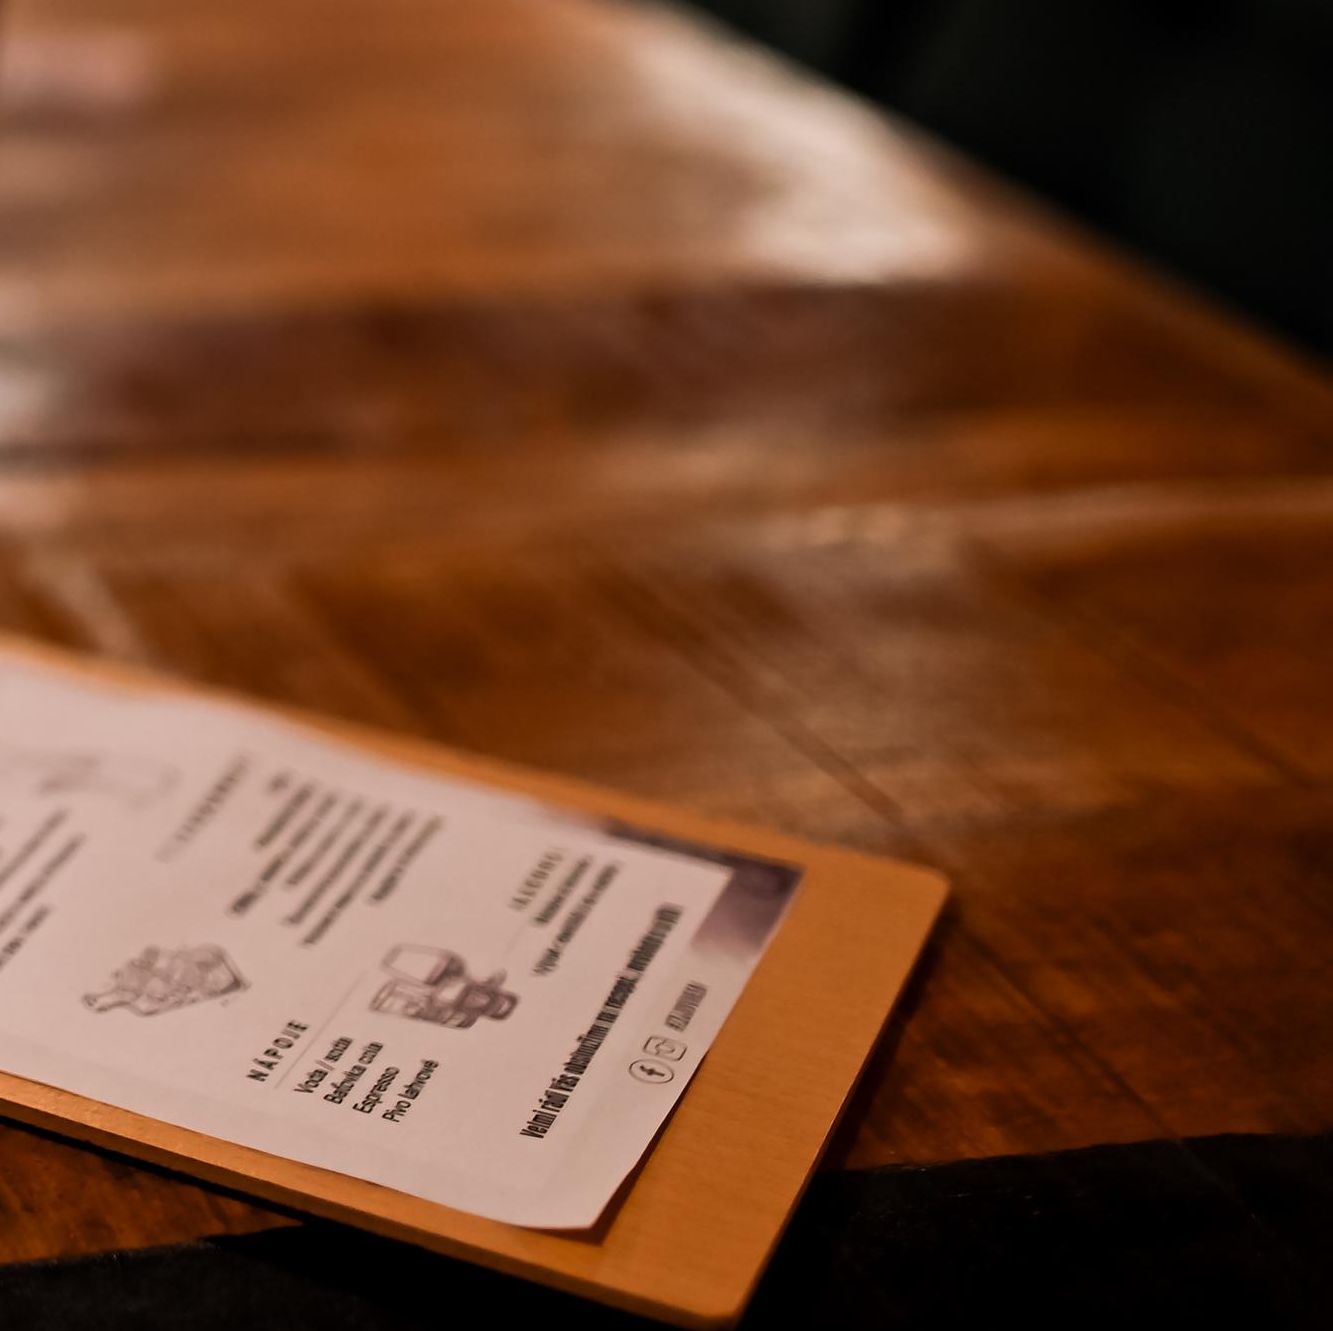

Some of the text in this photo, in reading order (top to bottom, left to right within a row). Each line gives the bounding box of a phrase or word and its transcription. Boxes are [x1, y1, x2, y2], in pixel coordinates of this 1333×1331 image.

[247, 1020, 308, 1082] NÁPOJE
[352, 1067, 400, 1114] Espresso
[381, 1100, 411, 1123] Pivo
[519, 1109, 557, 1139] Velmi
